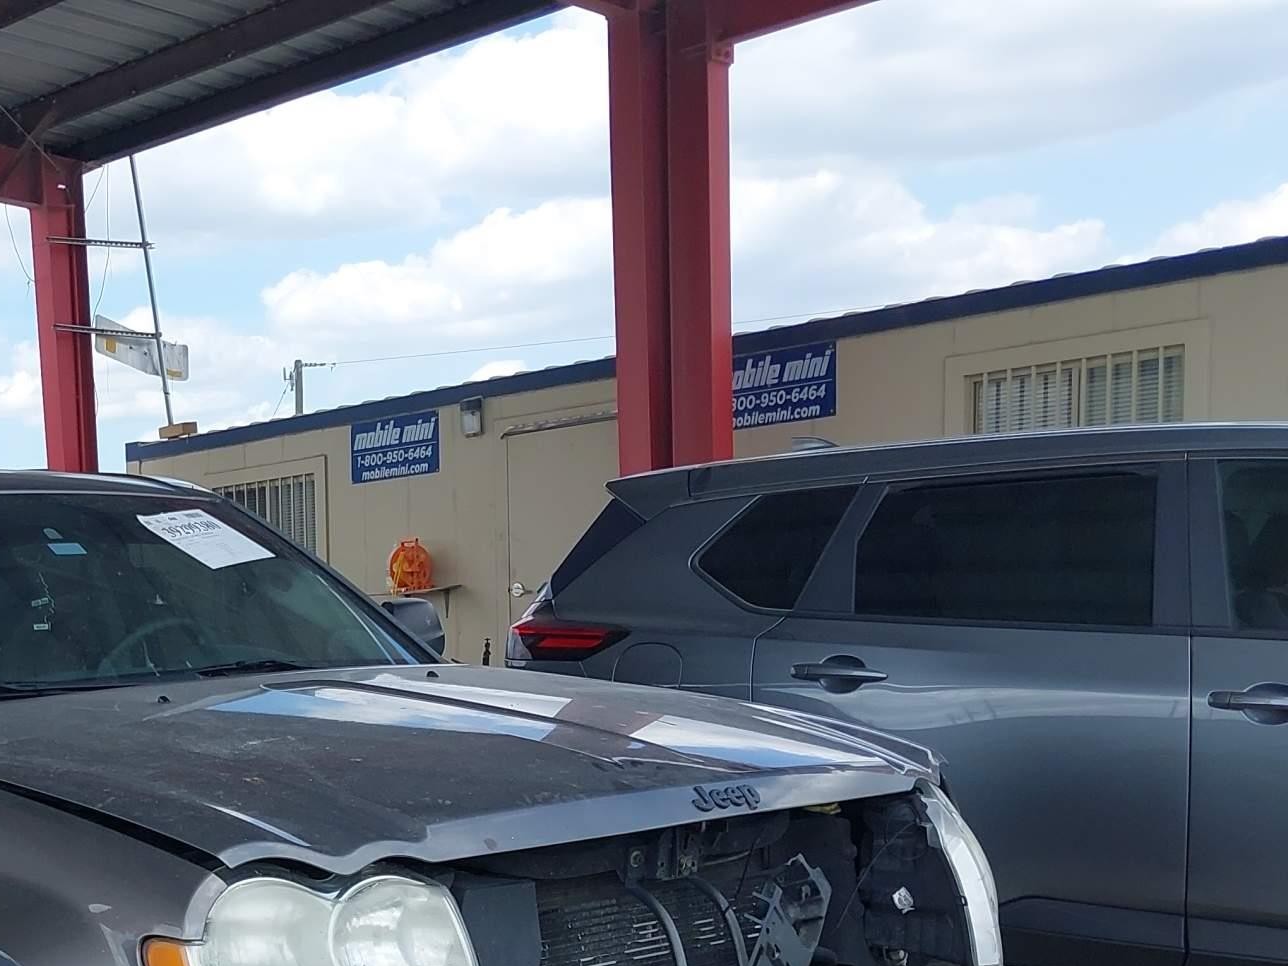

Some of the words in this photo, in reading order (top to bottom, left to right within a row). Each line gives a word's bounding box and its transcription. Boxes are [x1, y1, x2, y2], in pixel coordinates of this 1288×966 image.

[732, 355, 781, 390] obile
[782, 350, 832, 382] mini
[354, 420, 401, 450] mobile
[402, 417, 436, 443] mini
[357, 445, 432, 468] 1-800-950-6464
[362, 462, 429, 480] mobilemini.com
[691, 784, 760, 812] Jeep
